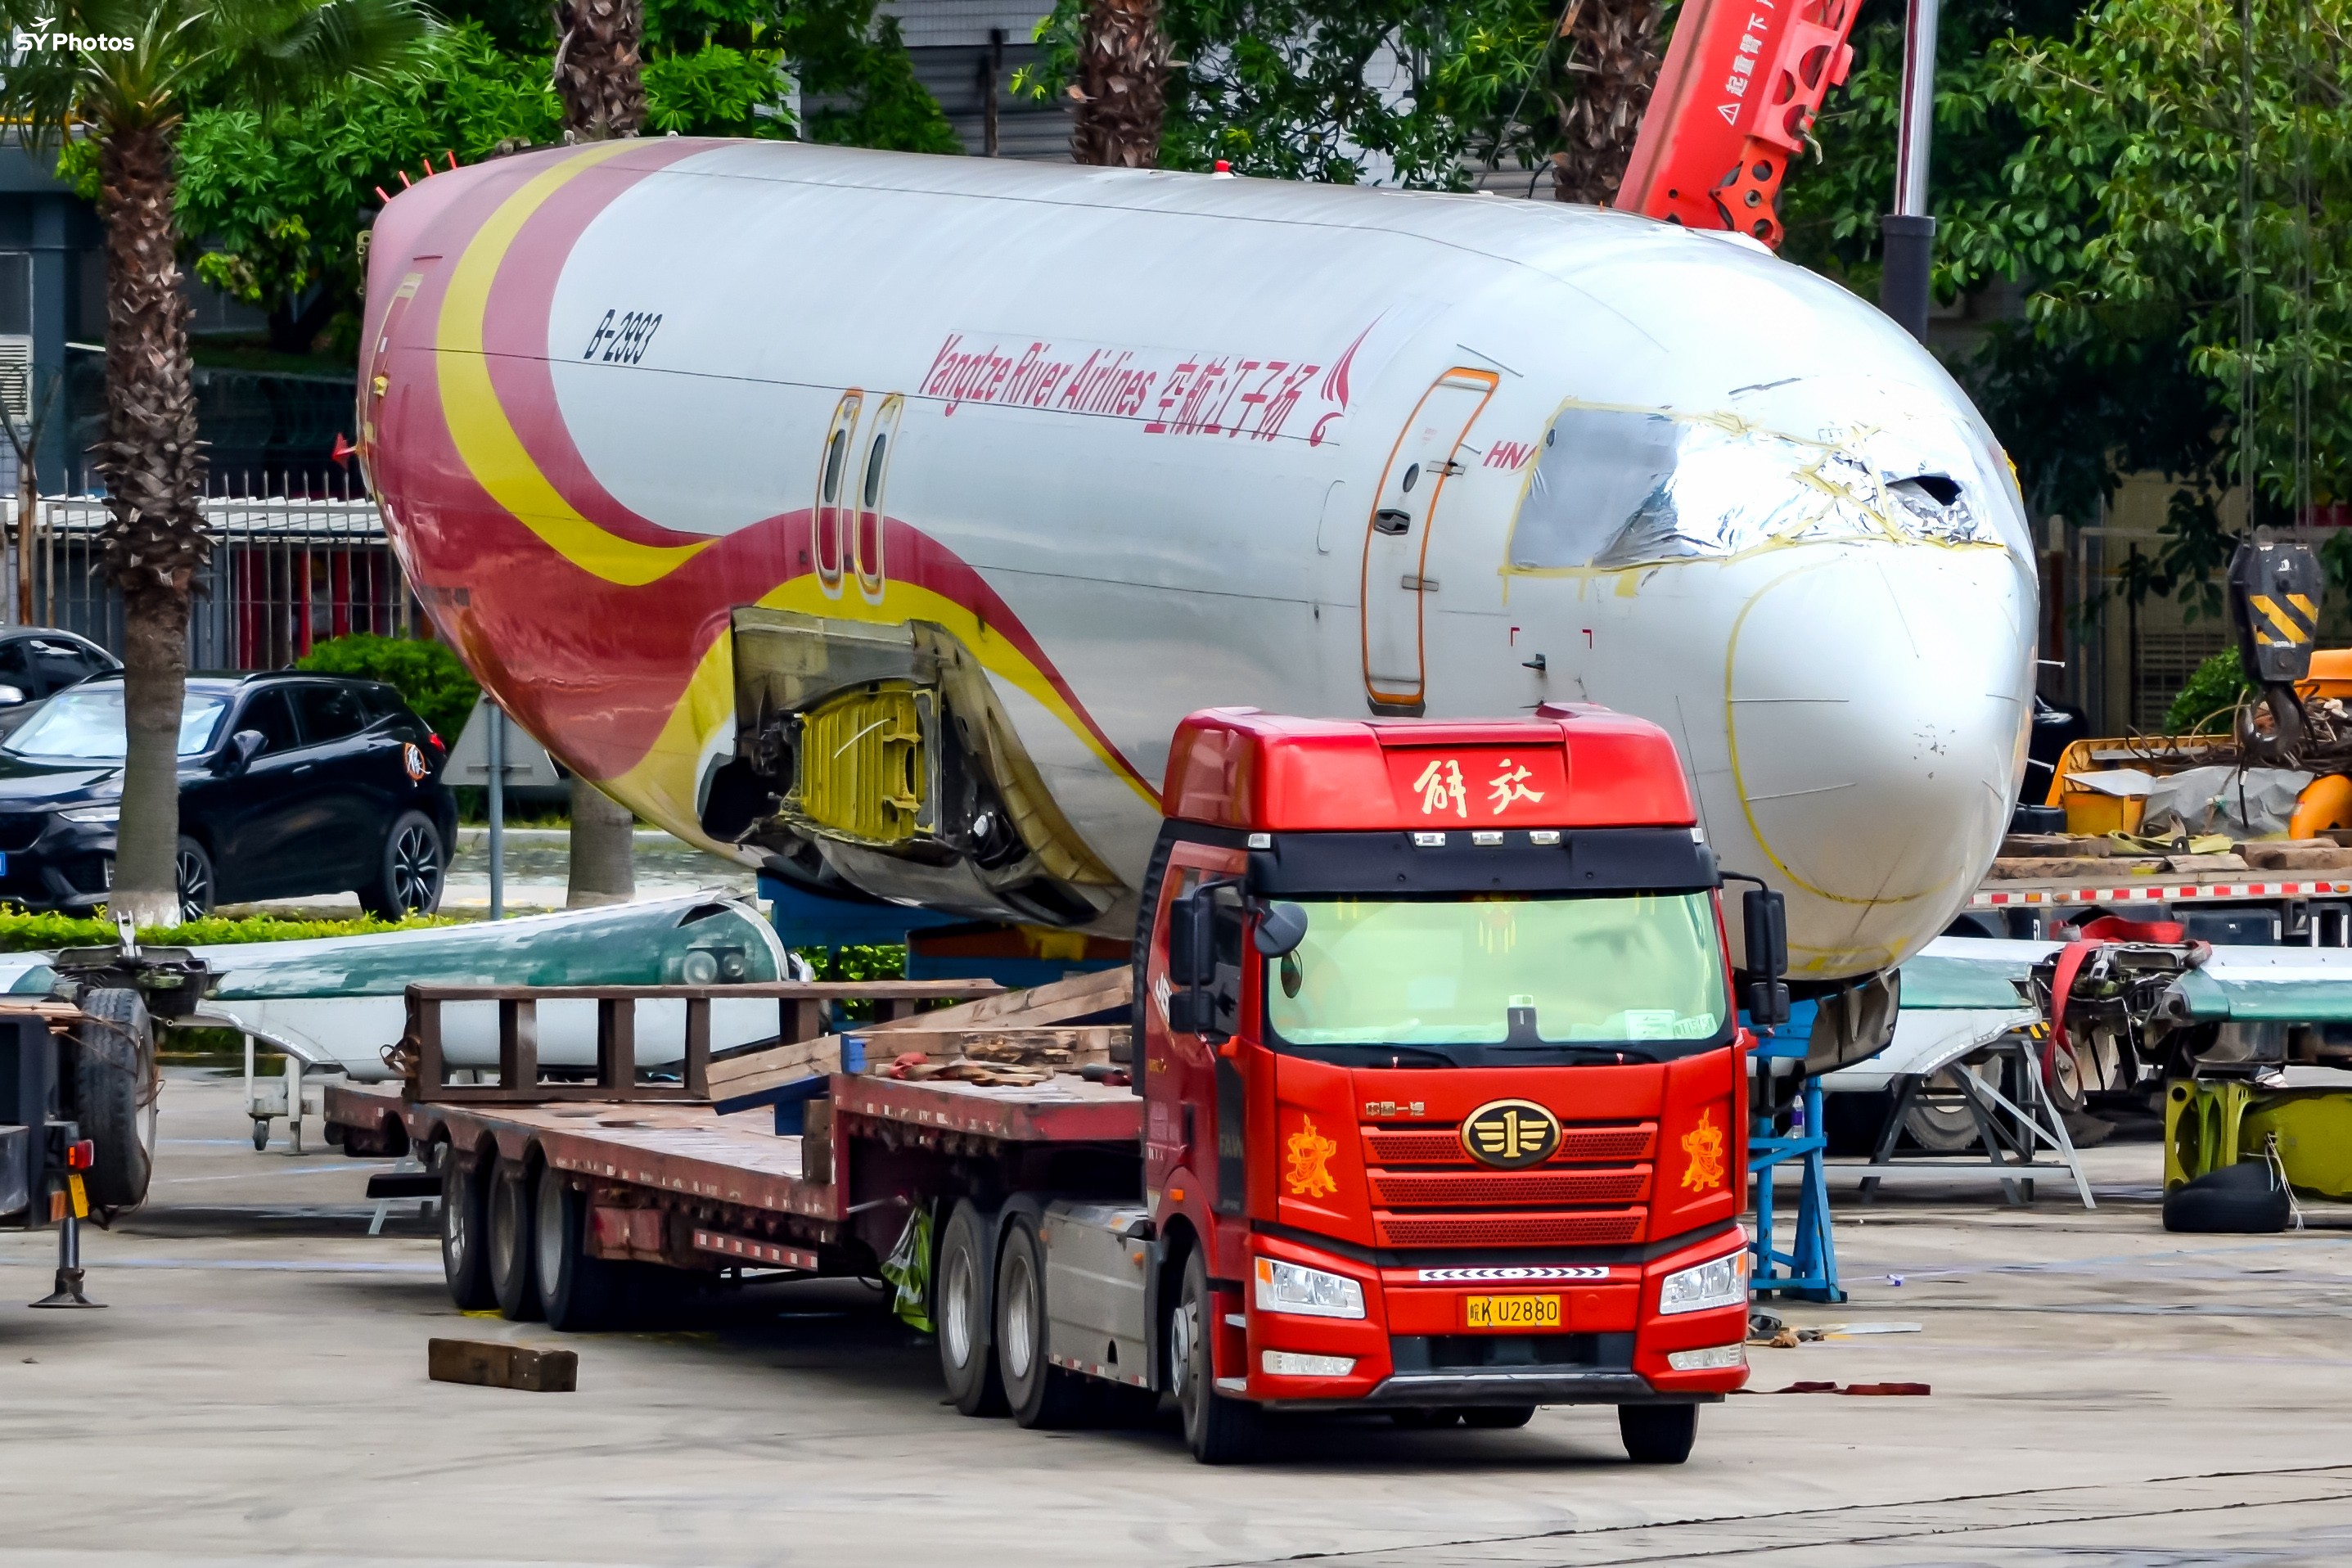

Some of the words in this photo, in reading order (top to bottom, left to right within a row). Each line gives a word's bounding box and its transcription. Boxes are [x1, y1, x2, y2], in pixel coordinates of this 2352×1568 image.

[583, 309, 663, 365] B-2993
[918, 334, 1013, 417] Yangtze
[999, 342, 1074, 408] River
[1057, 348, 1157, 417] Airlines
[1413, 758, 1545, 818] 解放
[1155, 971, 1172, 1025] J6
[1365, 1102, 1425, 1116] 中国一汽
